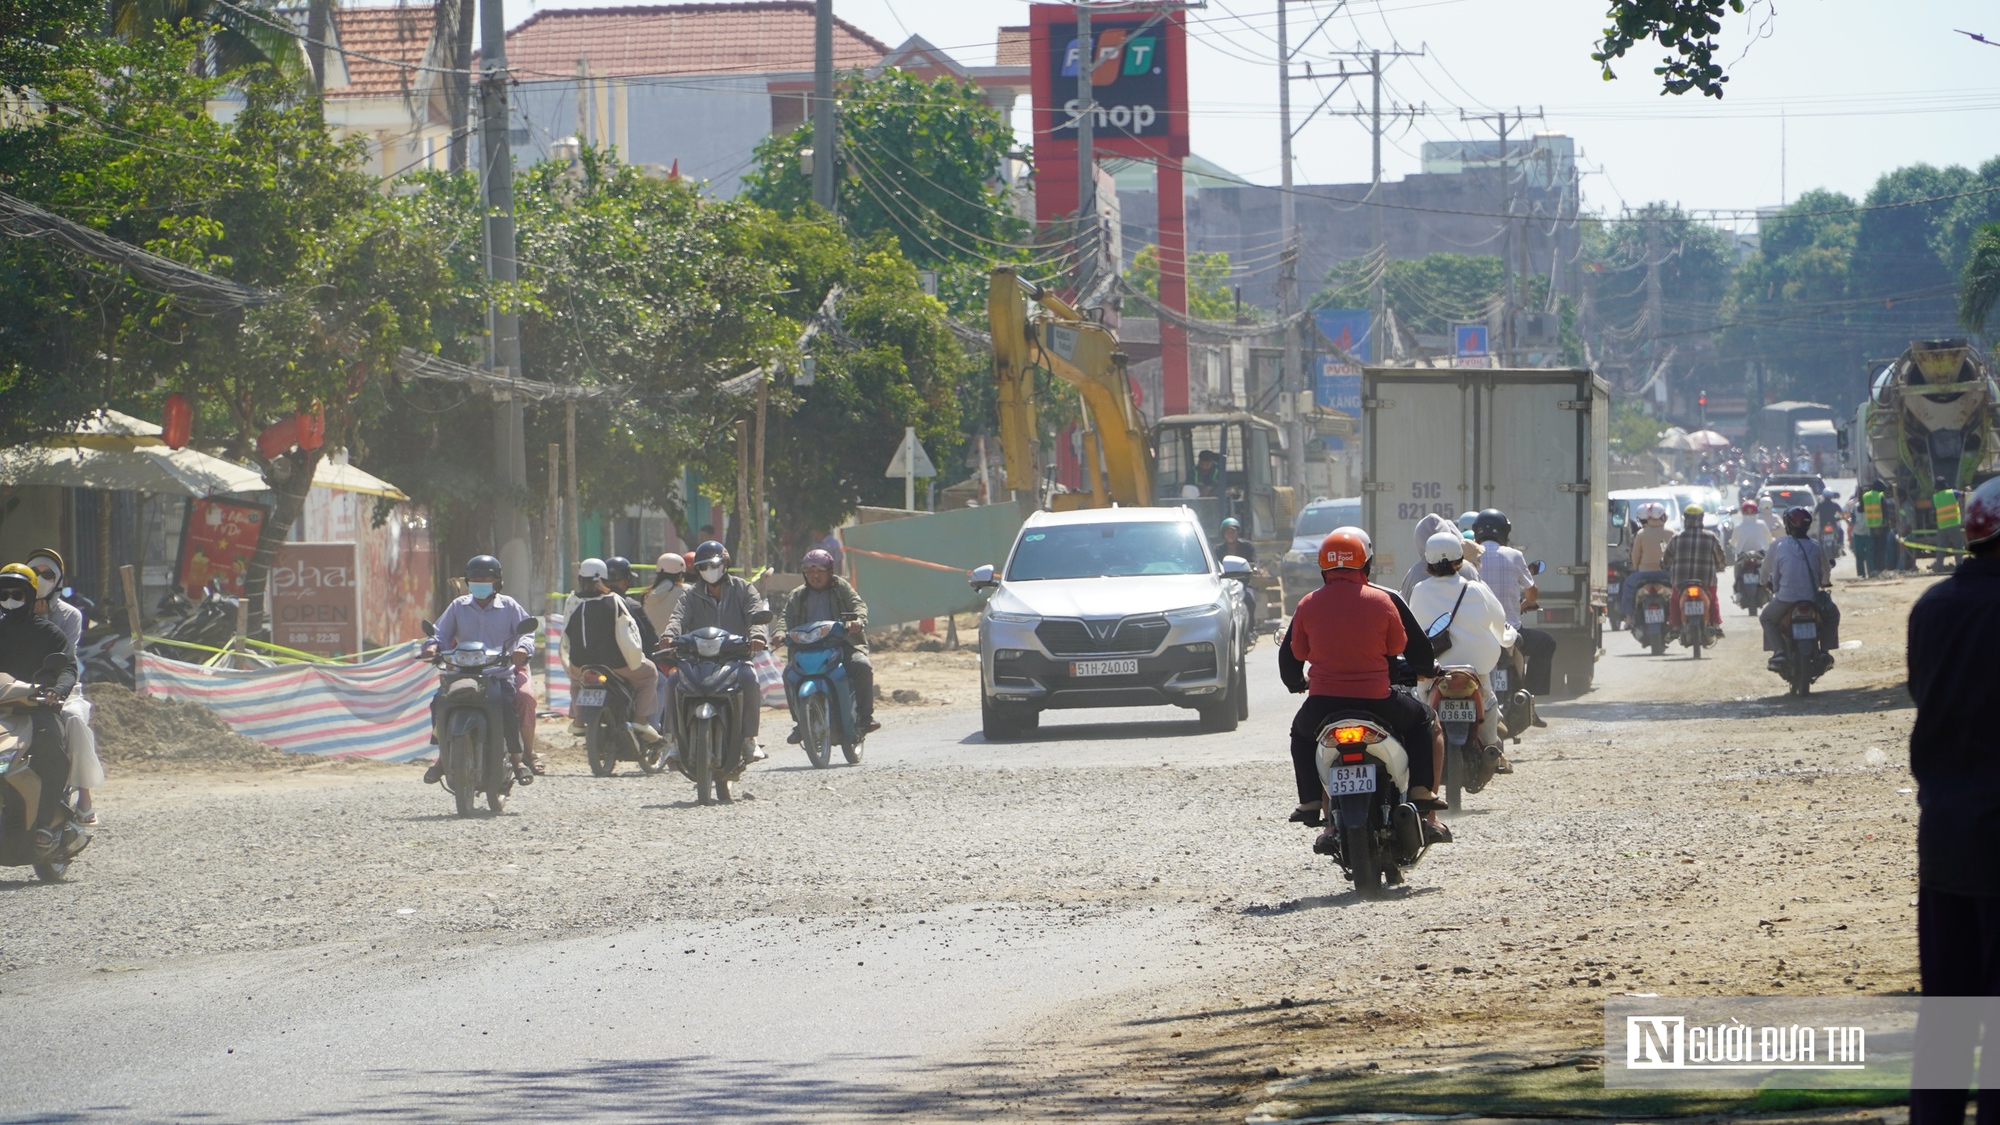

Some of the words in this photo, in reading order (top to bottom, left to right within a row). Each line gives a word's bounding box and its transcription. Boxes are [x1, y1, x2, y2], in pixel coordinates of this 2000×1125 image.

[1063, 99, 1156, 134] Shop
[1412, 482, 1441, 499] 51C
[1398, 503, 1455, 520] 82195
[281, 604, 348, 622] OPEN
[316, 633, 341, 643] 22:30
[1077, 660, 1136, 675] 51H-240.03
[1444, 701, 1470, 711] 86-AA
[1441, 710, 1473, 720] 036.96
[1337, 766, 1368, 780] 63-AA
[1333, 779, 1373, 793] 353.20
